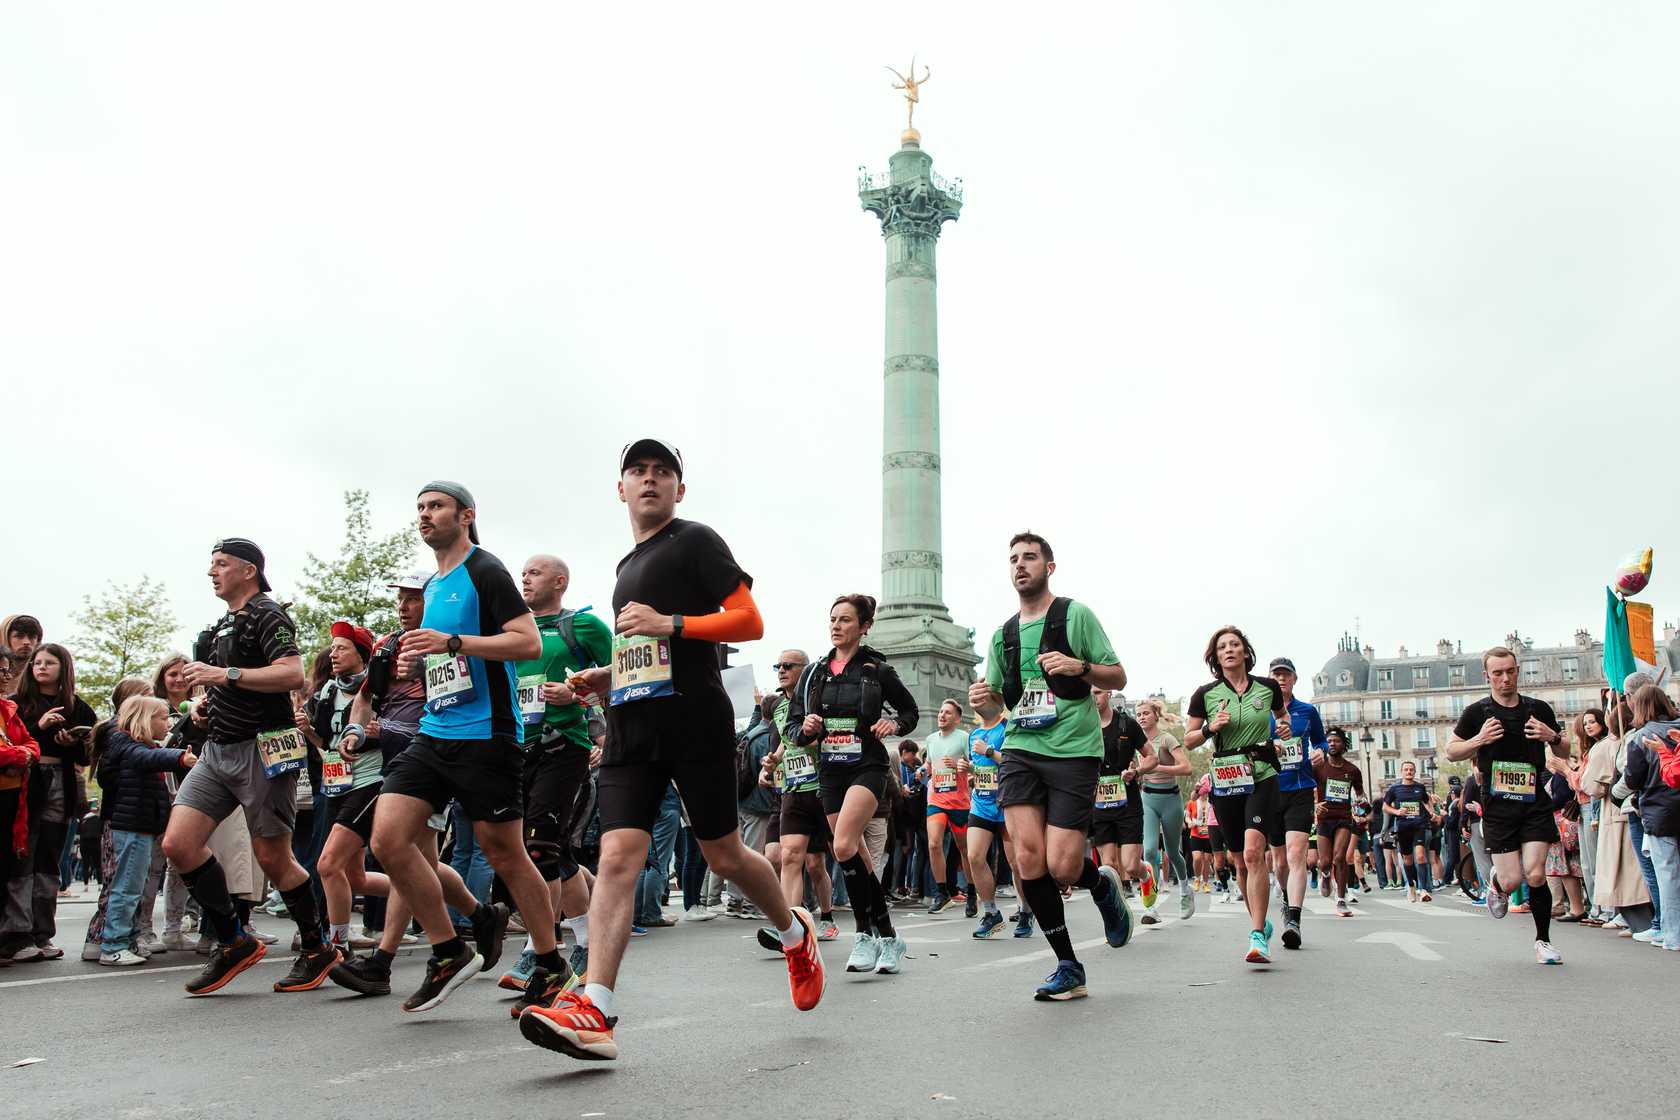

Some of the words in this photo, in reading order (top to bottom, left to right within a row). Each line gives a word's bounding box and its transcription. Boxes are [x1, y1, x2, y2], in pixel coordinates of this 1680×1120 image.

[617, 644, 653, 674] 31086
[630, 685, 651, 698] asics
[440, 695, 458, 707] asics
[262, 734, 297, 755] 29168
[287, 761, 300, 769] asics
[786, 756, 807, 771] 27170
[1215, 766, 1243, 780] 38684
[1499, 773, 1526, 785] 11993
